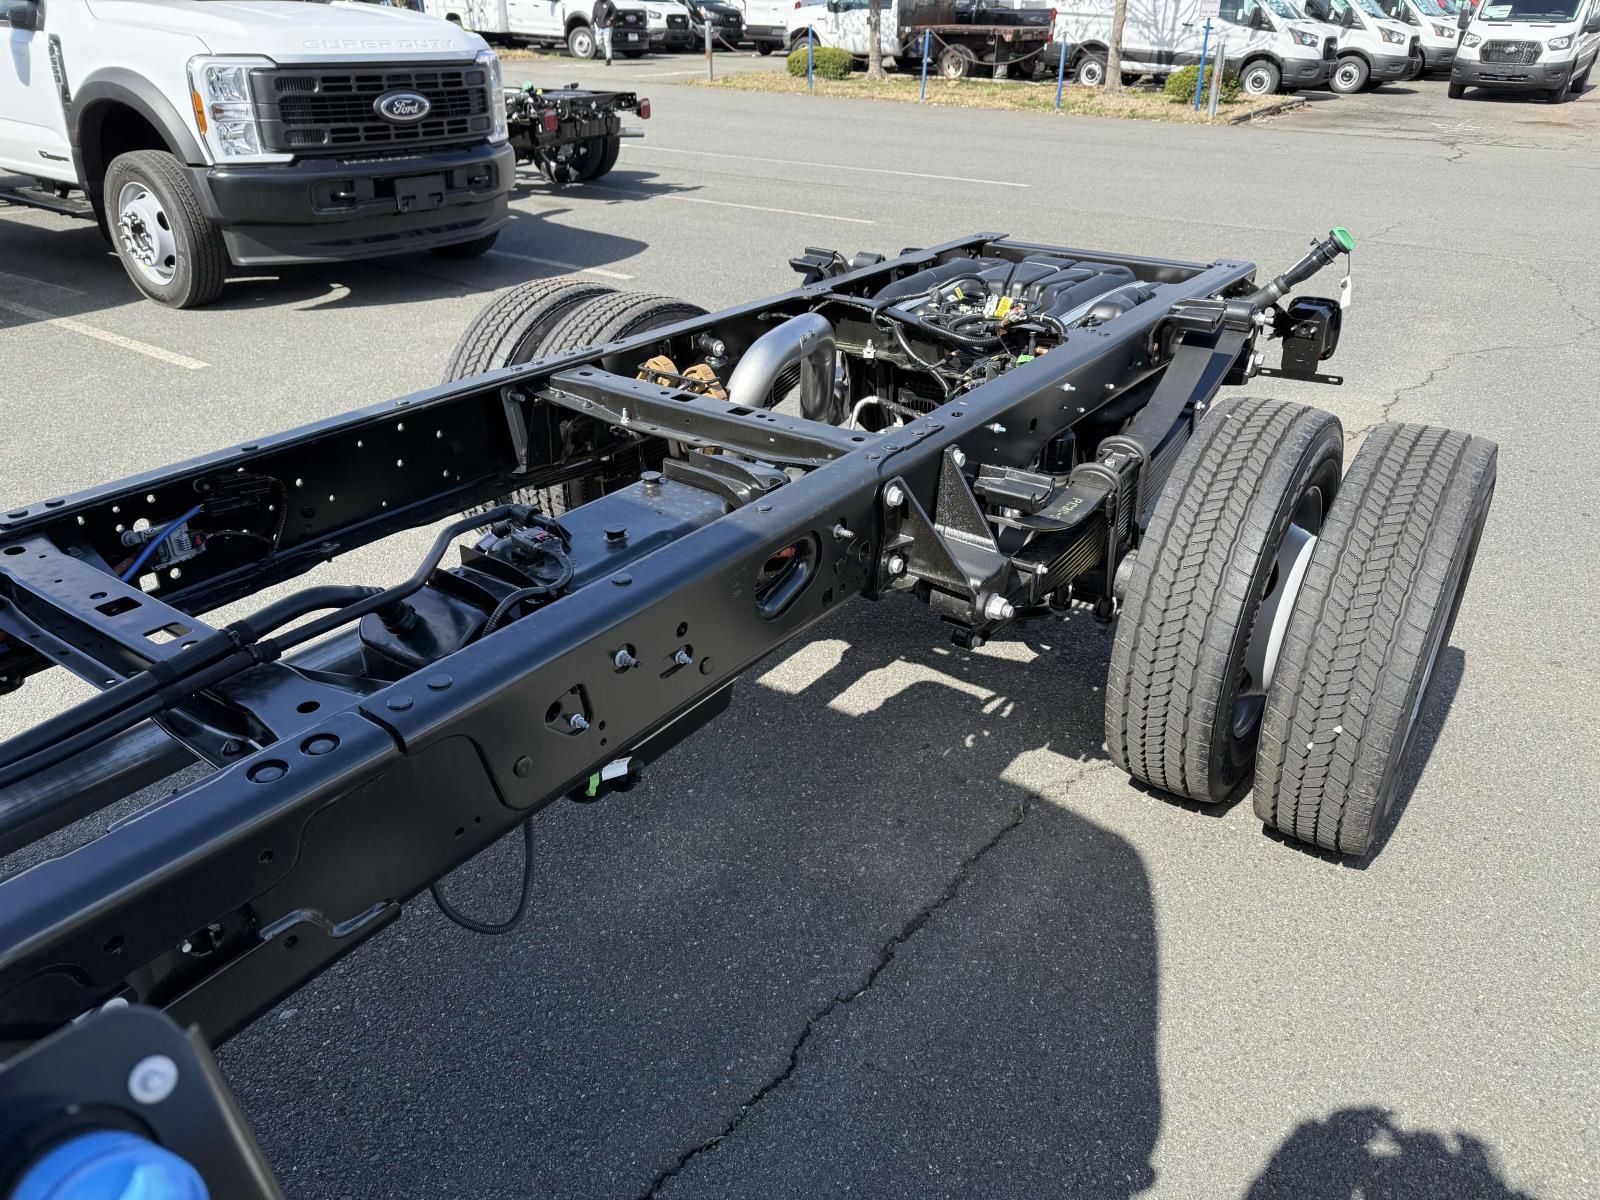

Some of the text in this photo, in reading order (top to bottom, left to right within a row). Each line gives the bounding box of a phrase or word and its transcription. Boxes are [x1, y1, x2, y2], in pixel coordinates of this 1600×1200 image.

[302, 38, 454, 49] SUPER DUTY
[393, 99, 419, 115] Ford
